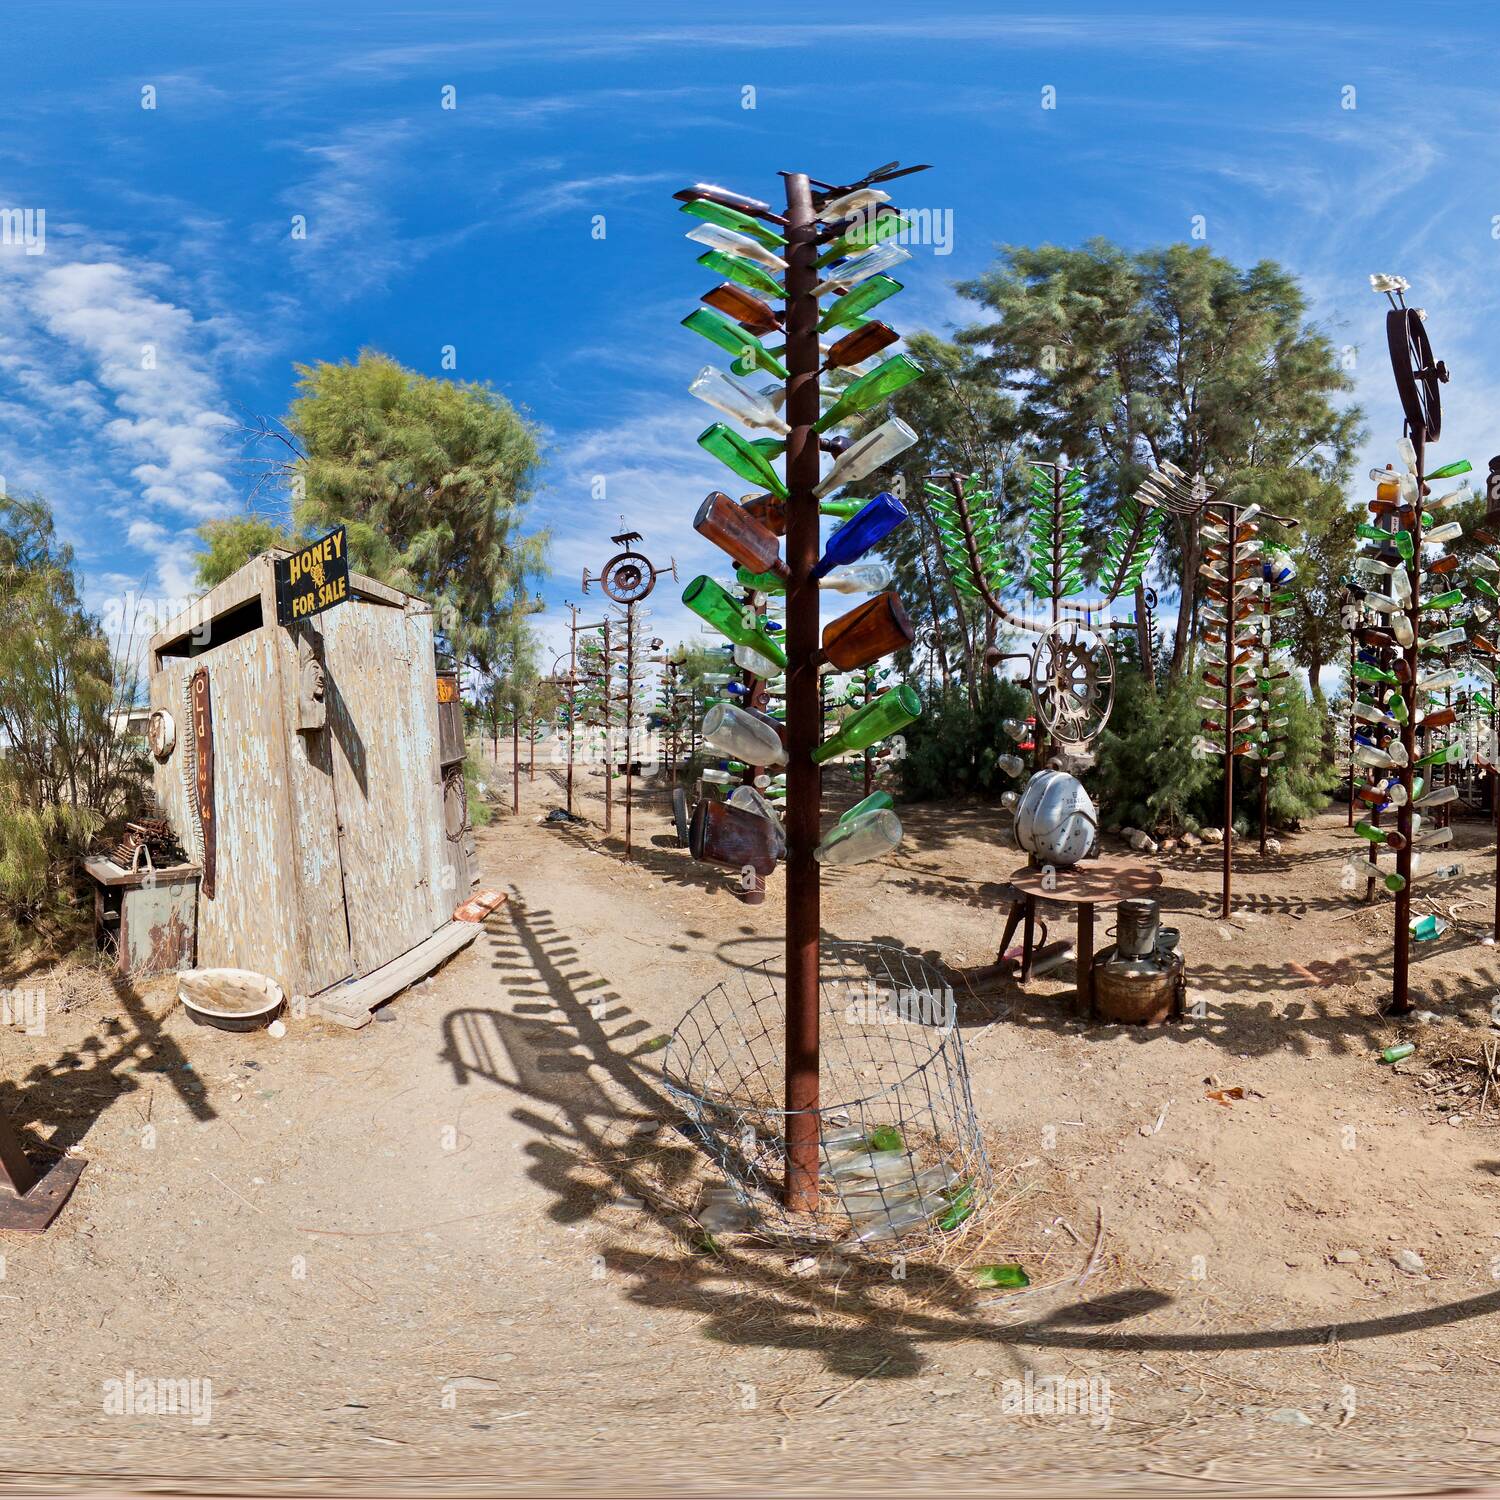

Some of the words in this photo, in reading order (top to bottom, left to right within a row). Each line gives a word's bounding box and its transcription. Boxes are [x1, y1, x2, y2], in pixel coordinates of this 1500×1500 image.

[290, 531, 343, 585] HONEY
[292, 592, 315, 618] FOR
[319, 576, 346, 608] SALE
